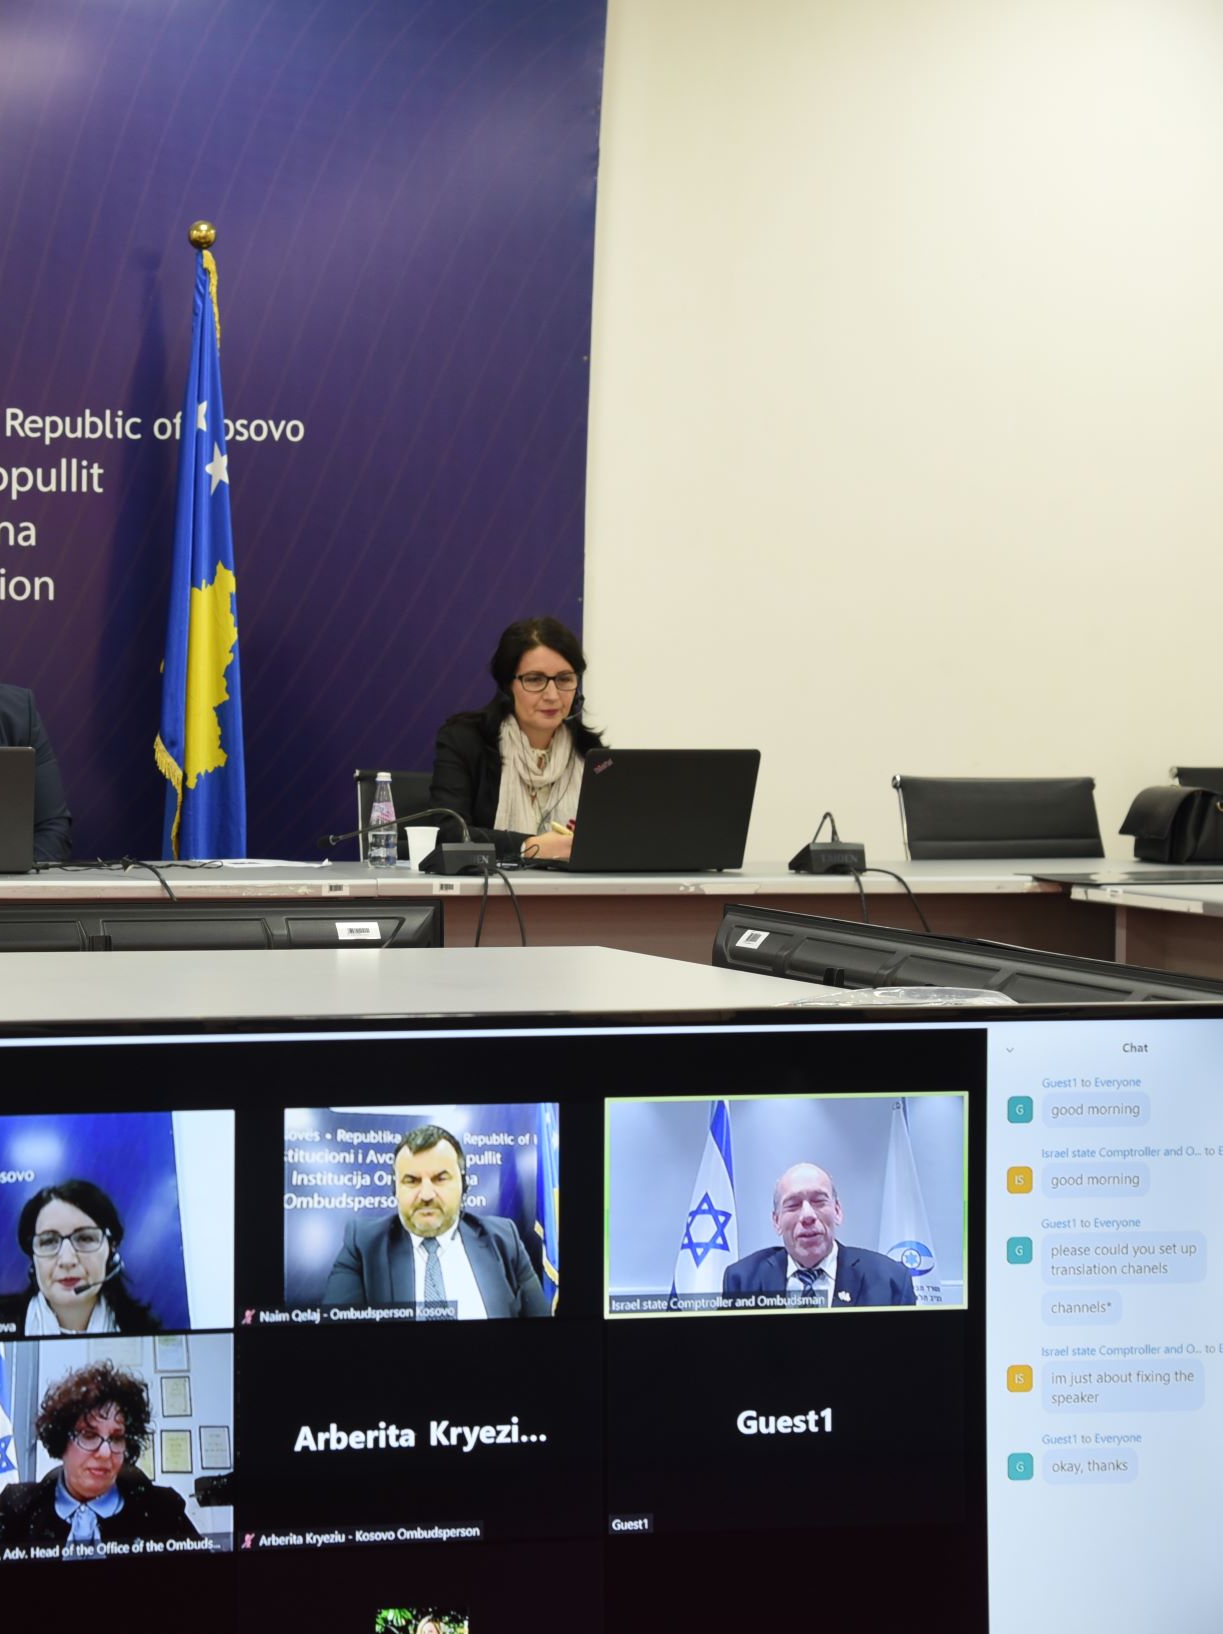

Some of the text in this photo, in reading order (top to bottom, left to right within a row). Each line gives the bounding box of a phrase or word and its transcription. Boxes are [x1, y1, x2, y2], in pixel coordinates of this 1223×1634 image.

[5, 407, 142, 446] Republic
[153, 411, 182, 441] of
[223, 418, 305, 442] osovo
[1122, 1042, 1148, 1054] Chat
[1042, 1077, 1141, 1090] Guest1 to Everyone
[1051, 1103, 1140, 1118] good morning
[336, 1129, 402, 1145] Republika
[463, 1132, 514, 1147] Republic
[518, 1132, 530, 1145] of
[466, 1150, 502, 1167] pullit
[1042, 1147, 1069, 1159] Israel
[1072, 1147, 1096, 1158] state
[1099, 1146, 1160, 1160] Comptroller
[1163, 1145, 1183, 1157] and
[1205, 1147, 1215, 1156] to
[292, 1170, 371, 1189] Institucija
[1051, 1173, 1140, 1189] good morning
[284, 1193, 398, 1212] Ombudsperso
[1041, 1217, 1141, 1230] Guest1 to Everyone
[1051, 1243, 1197, 1259] please could you set up
[1051, 1262, 1168, 1276] translation chanels
[612, 1294, 826, 1312] Israel state Comptroller and Ombudsman
[260, 1310, 290, 1323] Naim
[291, 1308, 320, 1324] Qelaj
[330, 1306, 414, 1322] Ombudsperson
[416, 1306, 456, 1319] Kosovo
[1041, 1346, 1069, 1357] Israel
[1072, 1345, 1096, 1356] state
[1099, 1344, 1161, 1358] Comptroller
[1163, 1343, 1184, 1355] and
[1205, 1344, 1216, 1354] to
[1051, 1369, 1194, 1387] im just about fixing the
[1051, 1391, 1099, 1406] speaker
[736, 1407, 833, 1436] Guest1
[294, 1421, 416, 1452] Arberita
[1041, 1433, 1142, 1446] Guest1 to Everyone
[1052, 1459, 1129, 1475] okay, thanks
[612, 1518, 649, 1531] Guest1
[259, 1532, 303, 1547] Arberita
[305, 1530, 345, 1547] Kryeziu
[355, 1529, 395, 1542] Kosovo
[397, 1526, 480, 1541] Ombudsperson
[3, 1547, 28, 1560] Adv.
[30, 1545, 60, 1559] Head
[62, 1543, 75, 1556] of
[75, 1543, 94, 1556] the
[96, 1541, 130, 1555] Office
[131, 1541, 144, 1554] of
[146, 1540, 164, 1553] the
